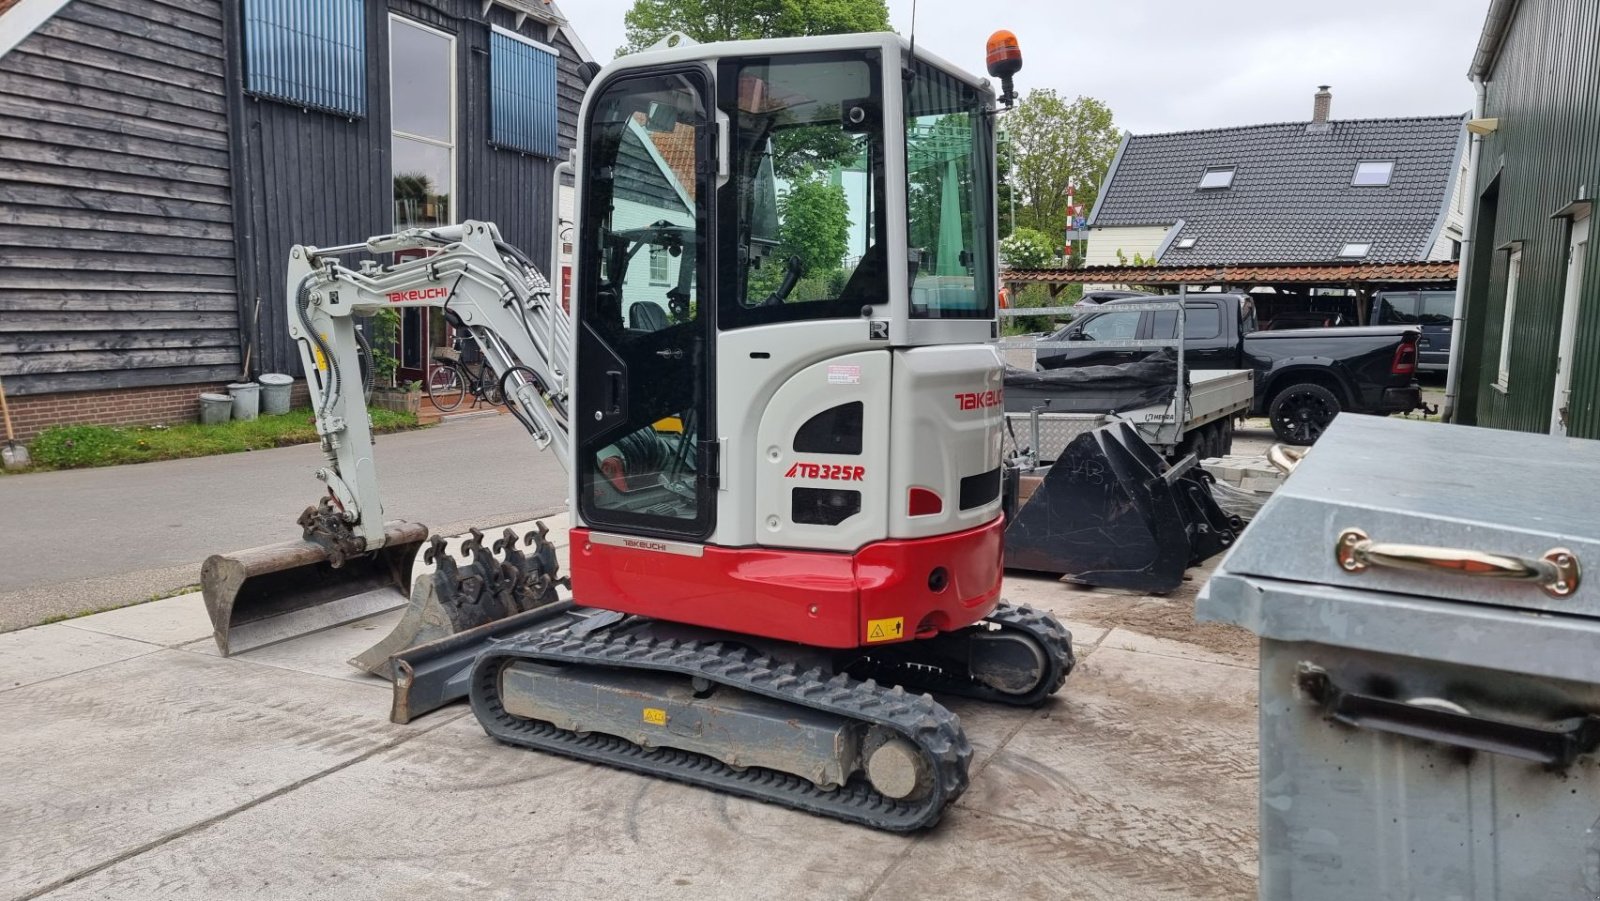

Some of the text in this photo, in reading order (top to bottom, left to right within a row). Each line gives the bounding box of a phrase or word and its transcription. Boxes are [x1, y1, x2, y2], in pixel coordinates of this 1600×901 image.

[385, 287, 448, 302] TAKEUCHI
[798, 463, 866, 481] TB325R
[623, 538, 666, 551] TAKEUCHI
